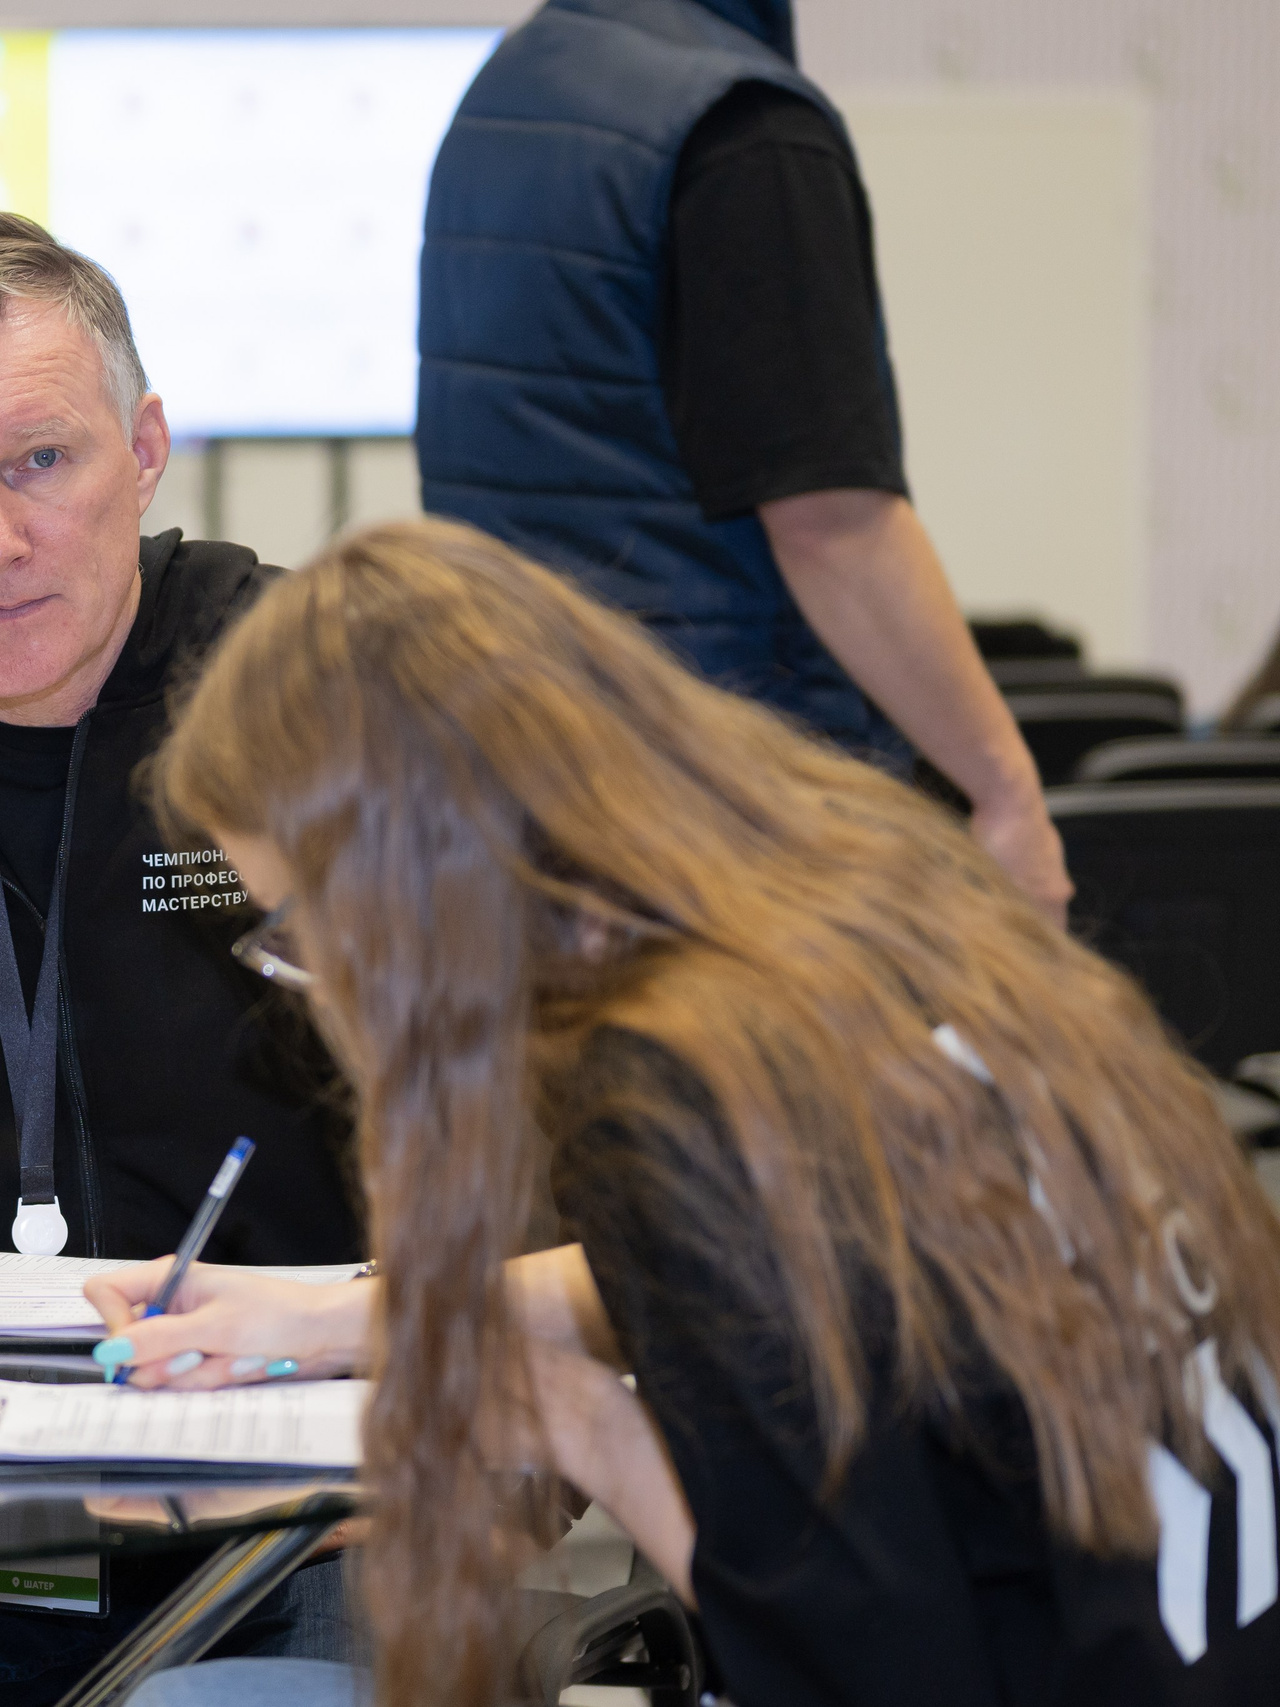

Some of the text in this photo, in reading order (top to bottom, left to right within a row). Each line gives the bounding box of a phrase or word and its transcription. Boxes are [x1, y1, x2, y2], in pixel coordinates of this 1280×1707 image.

[142, 876, 166, 890] ПО
[142, 889, 249, 912] МАСТЕРСТВУ
[23, 1580, 55, 1591] ШАТЕР
